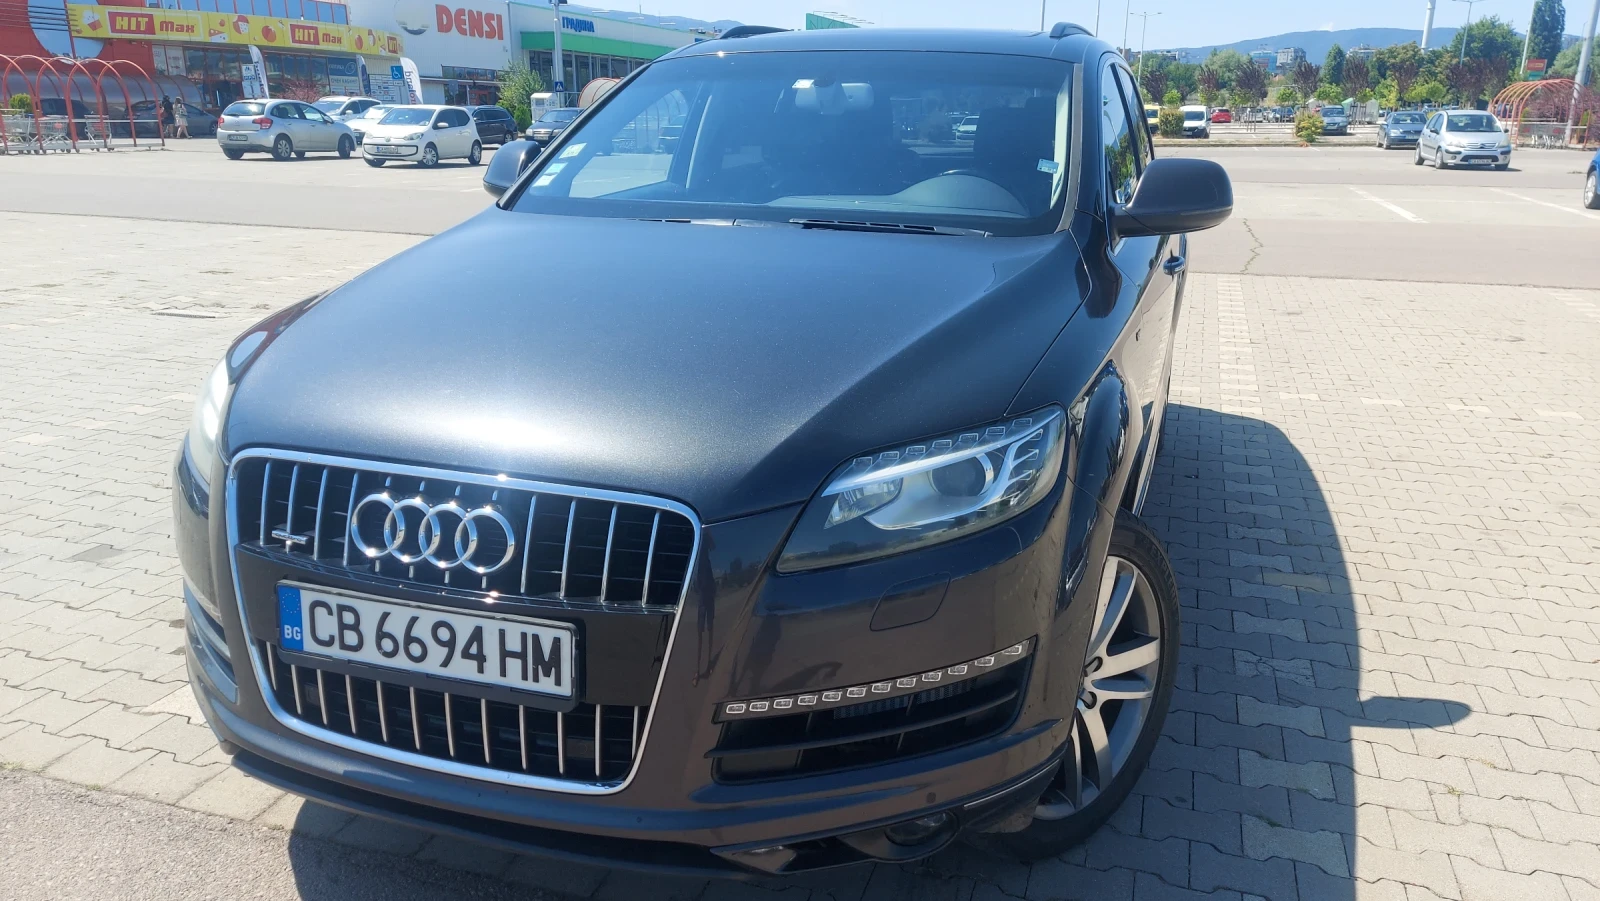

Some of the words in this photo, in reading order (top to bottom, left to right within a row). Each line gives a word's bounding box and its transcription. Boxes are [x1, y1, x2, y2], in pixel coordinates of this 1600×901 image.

[115, 16, 149, 31] HIT
[159, 20, 195, 33] Max
[435, 4, 504, 41] DENSI
[562, 16, 595, 33] ГРАДИНА
[294, 28, 316, 42] HIT
[322, 33, 342, 44] Max
[284, 624, 302, 641] BG
[308, 599, 364, 653] CB
[374, 610, 487, 675] 6694
[498, 628, 562, 687] HM
